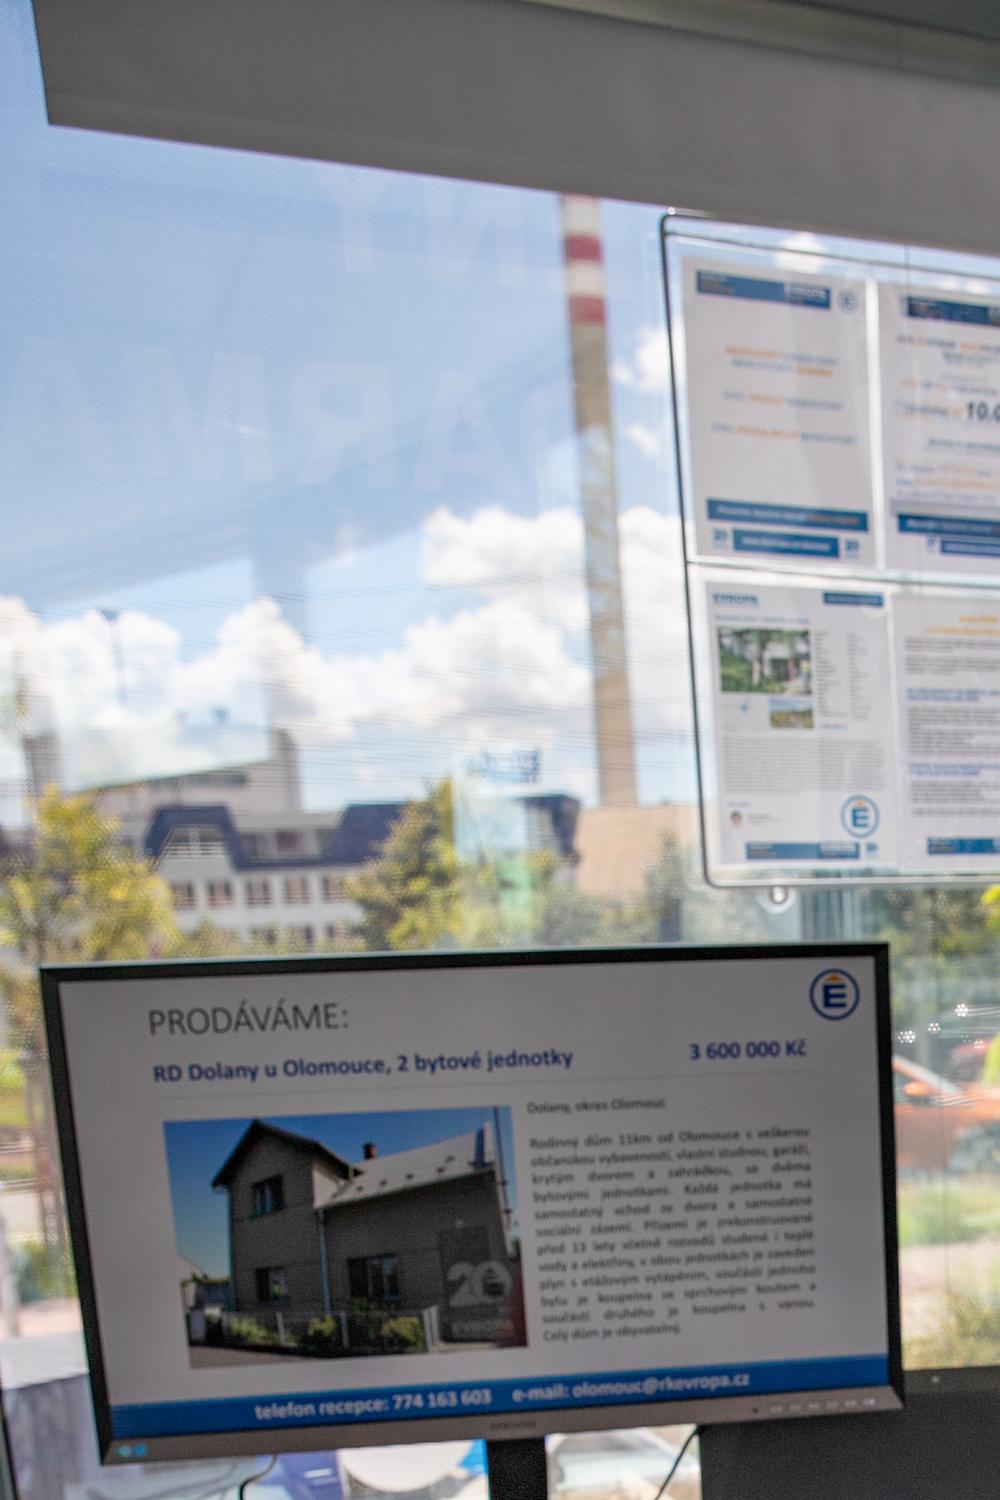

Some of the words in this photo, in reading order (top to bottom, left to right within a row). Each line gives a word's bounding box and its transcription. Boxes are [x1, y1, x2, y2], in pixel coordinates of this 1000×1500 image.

[148, 998, 349, 1036] PRODÁVÁME:
[153, 1064, 183, 1083] RD
[188, 1061, 258, 1083] Dolany
[265, 1065, 278, 1078] u
[283, 1058, 392, 1078] Olomouce,
[397, 1055, 409, 1073] 2
[414, 1051, 482, 1075] bytové
[486, 1047, 574, 1073] jednotky
[690, 1044, 700, 1061] 3
[706, 1042, 741, 1060] 600
[745, 1041, 781, 1058] 000
[785, 1039, 807, 1057] Kč
[254, 1401, 316, 1421] telefon
[319, 1397, 389, 1419] recepce:
[392, 1392, 424, 1411] 774
[428, 1390, 458, 1409] 163
[461, 1388, 492, 1406] 603
[511, 1384, 570, 1403] e-mail:
[573, 1372, 751, 1400] olomouc@rkevropa.cz
